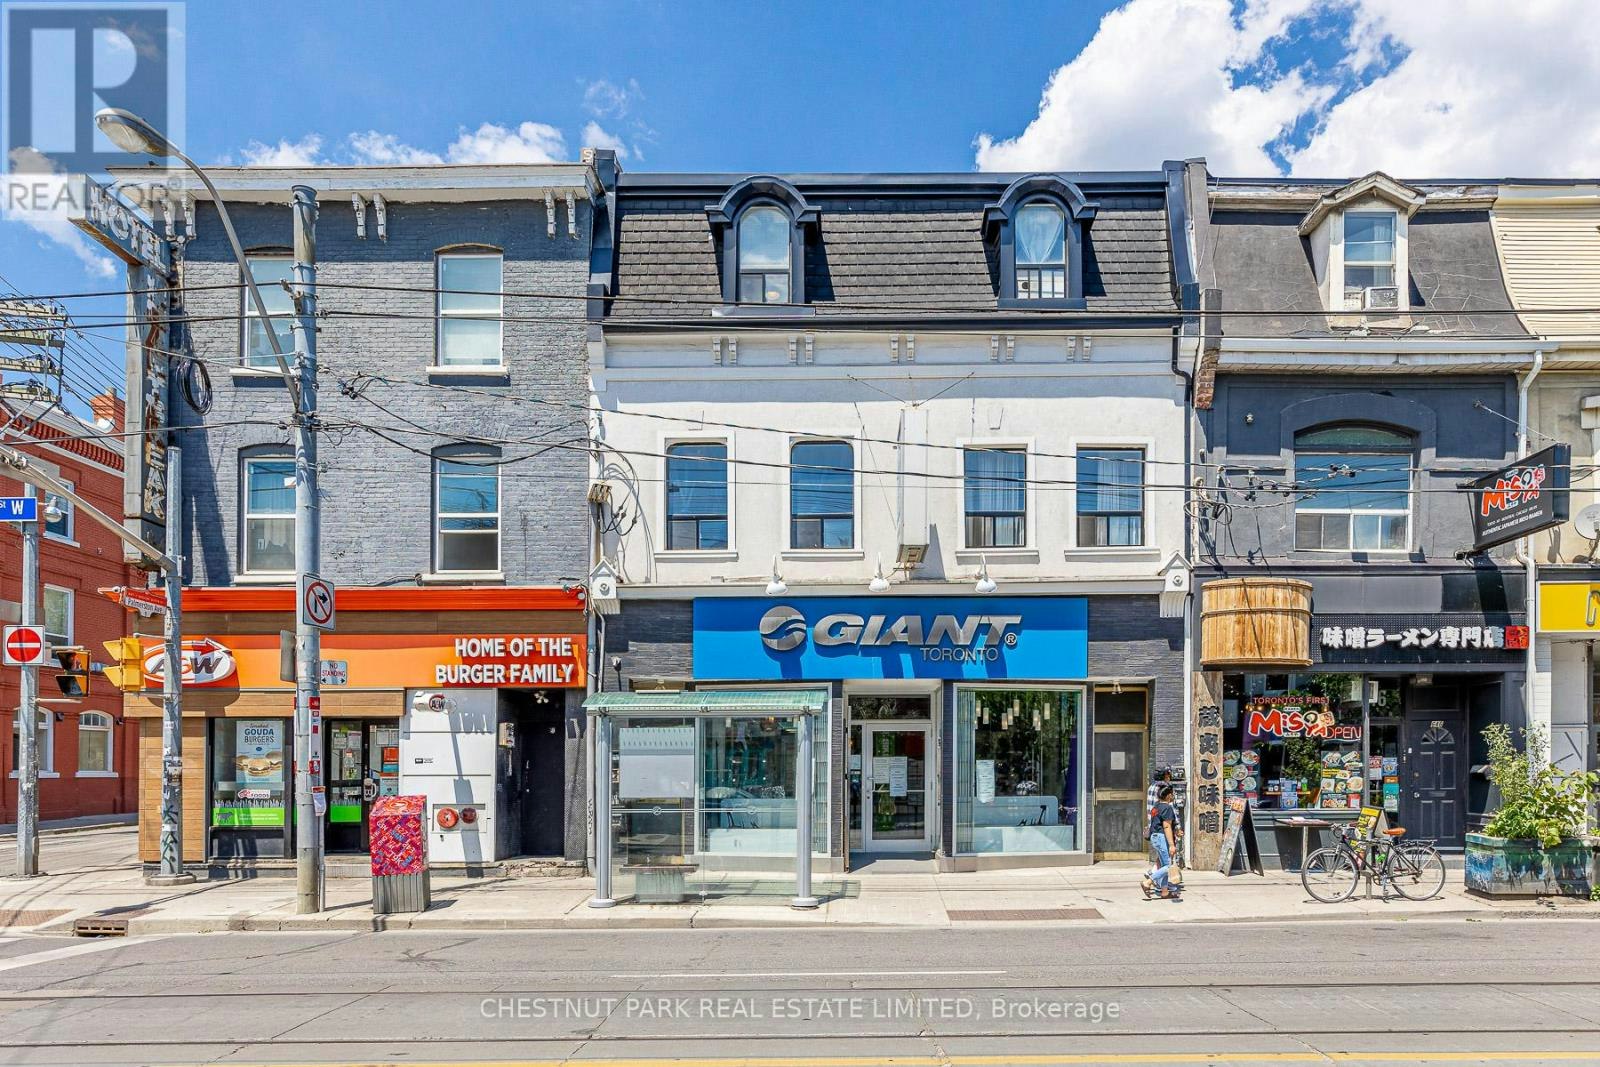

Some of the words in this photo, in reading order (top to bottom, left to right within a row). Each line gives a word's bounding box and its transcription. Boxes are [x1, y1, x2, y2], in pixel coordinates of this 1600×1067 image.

[11, 500, 24, 515] W
[813, 613, 1022, 647] GIANT
[1321, 626, 1503, 649] 味噌ラーメン専門店
[455, 637, 506, 657] HOME
[510, 637, 535, 657] OF
[538, 637, 573, 657] THE
[920, 647, 1000, 663] TORONTO
[435, 664, 506, 684] BURGER
[510, 664, 574, 684] FAMILY
[1253, 696, 1303, 705] TORONTO'S
[1306, 696, 1330, 705] FIRST
[244, 728, 274, 736] GOUDA
[244, 735, 275, 743] BURGERS
[1327, 726, 1362, 739] OPEN
